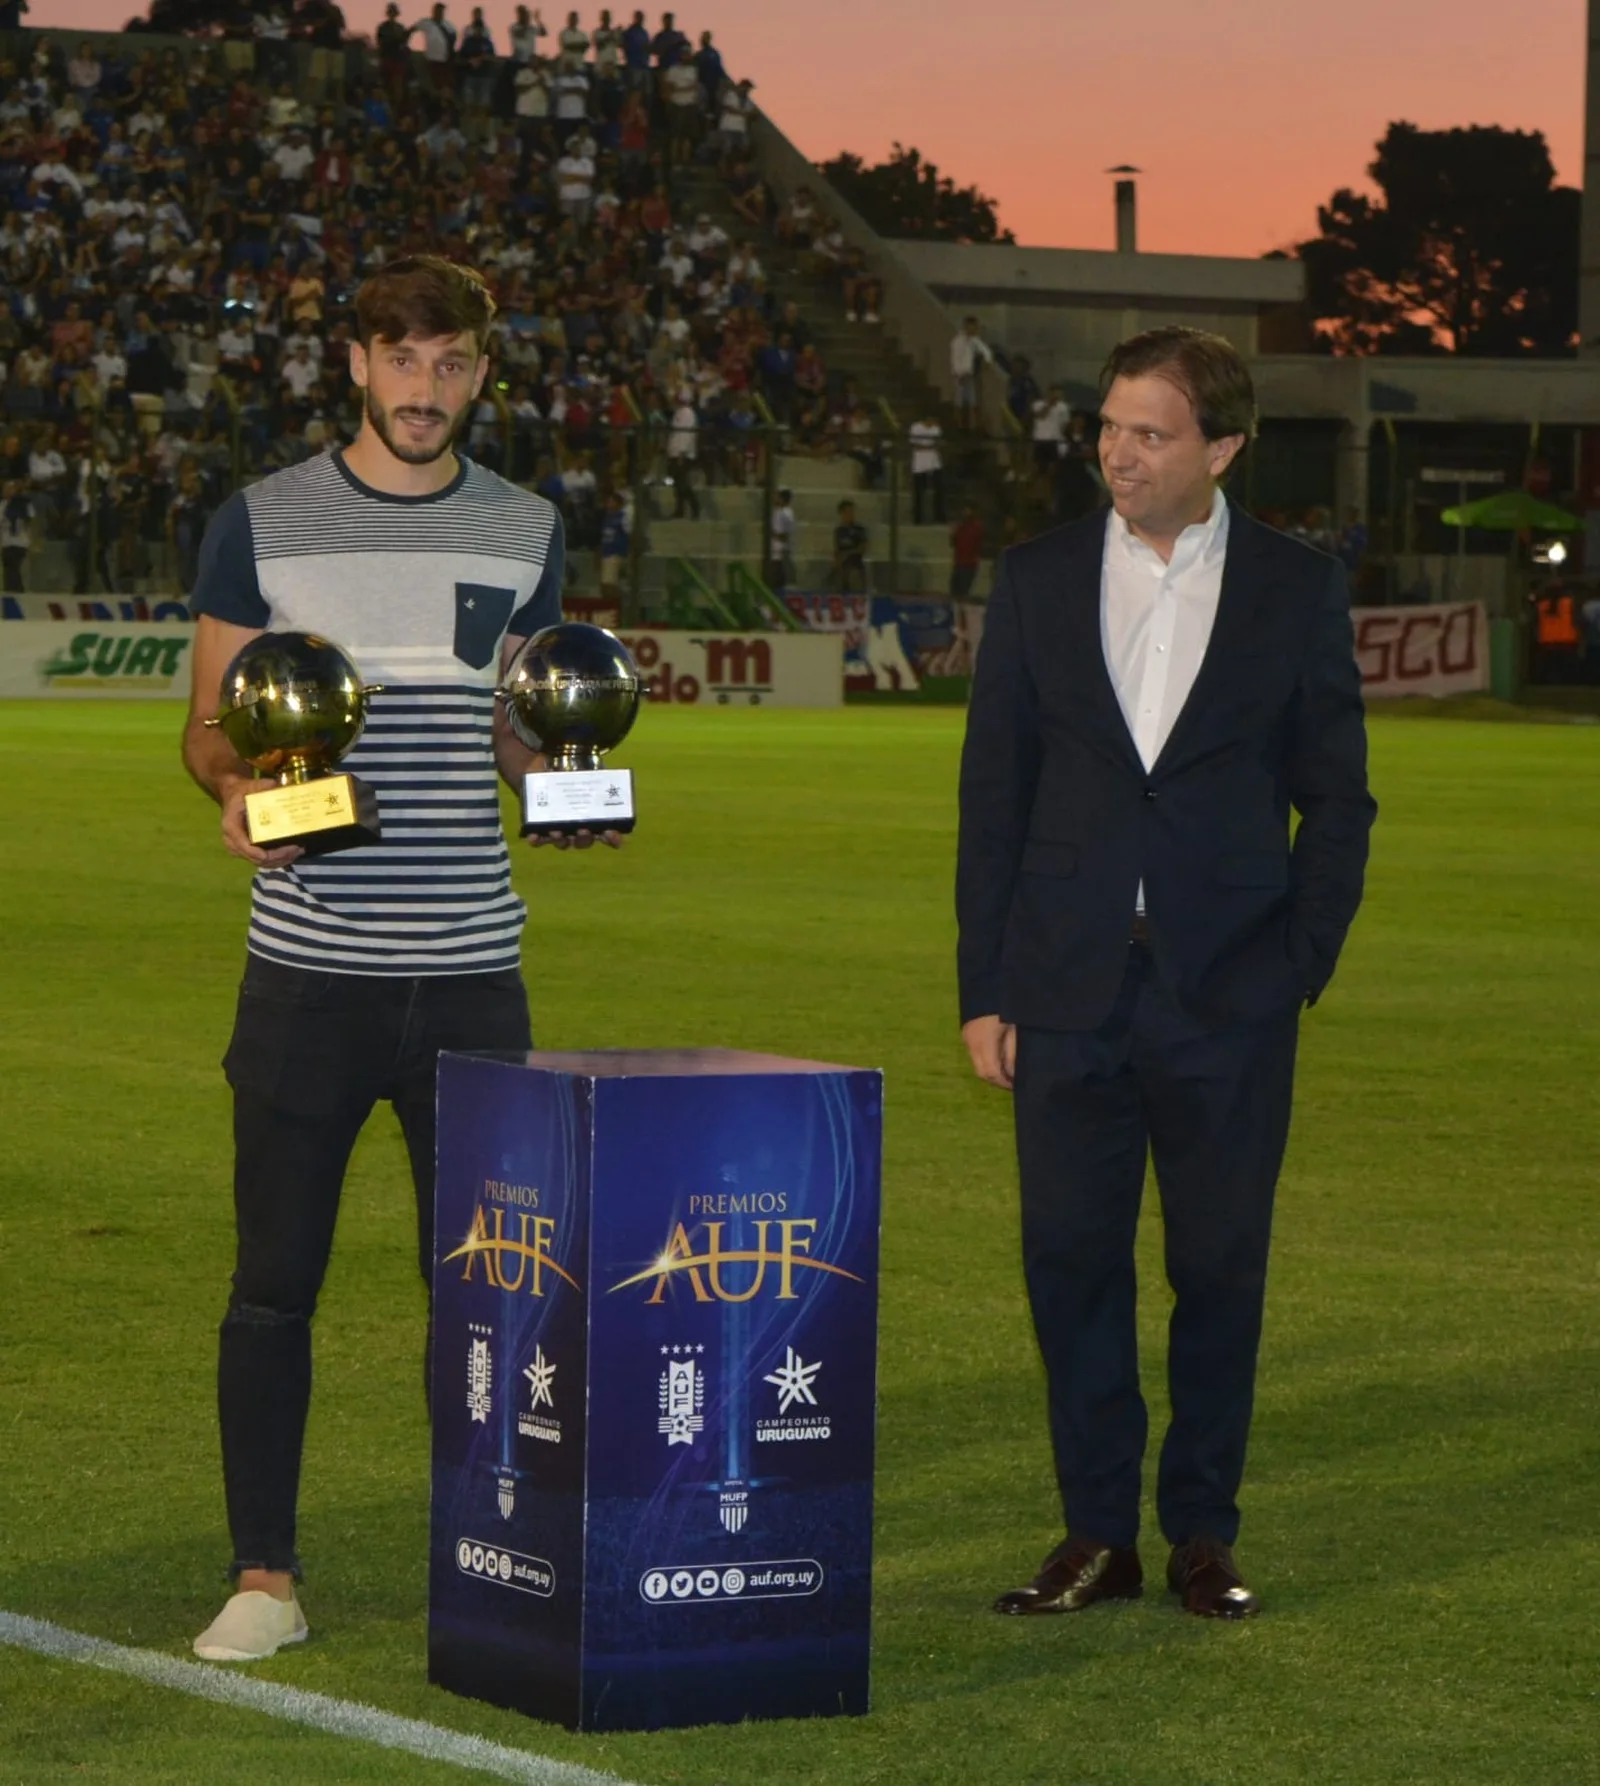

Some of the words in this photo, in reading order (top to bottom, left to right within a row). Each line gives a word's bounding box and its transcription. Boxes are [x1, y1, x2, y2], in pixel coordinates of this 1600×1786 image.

[46, 633, 190, 677] SUAT
[484, 1179, 540, 1209] PREMIOS
[689, 1191, 788, 1215] PREMIOS
[460, 1203, 556, 1297] AUF
[643, 1217, 817, 1305] AUF
[673, 1369, 690, 1409] AUF
[518, 1420, 561, 1444] URUGUAYO
[756, 1416, 831, 1429] CAMPEONATO
[756, 1427, 831, 1443] URUGUAYO
[719, 1491, 749, 1503] MUFP
[749, 1569, 815, 1588] auf.org.uy
